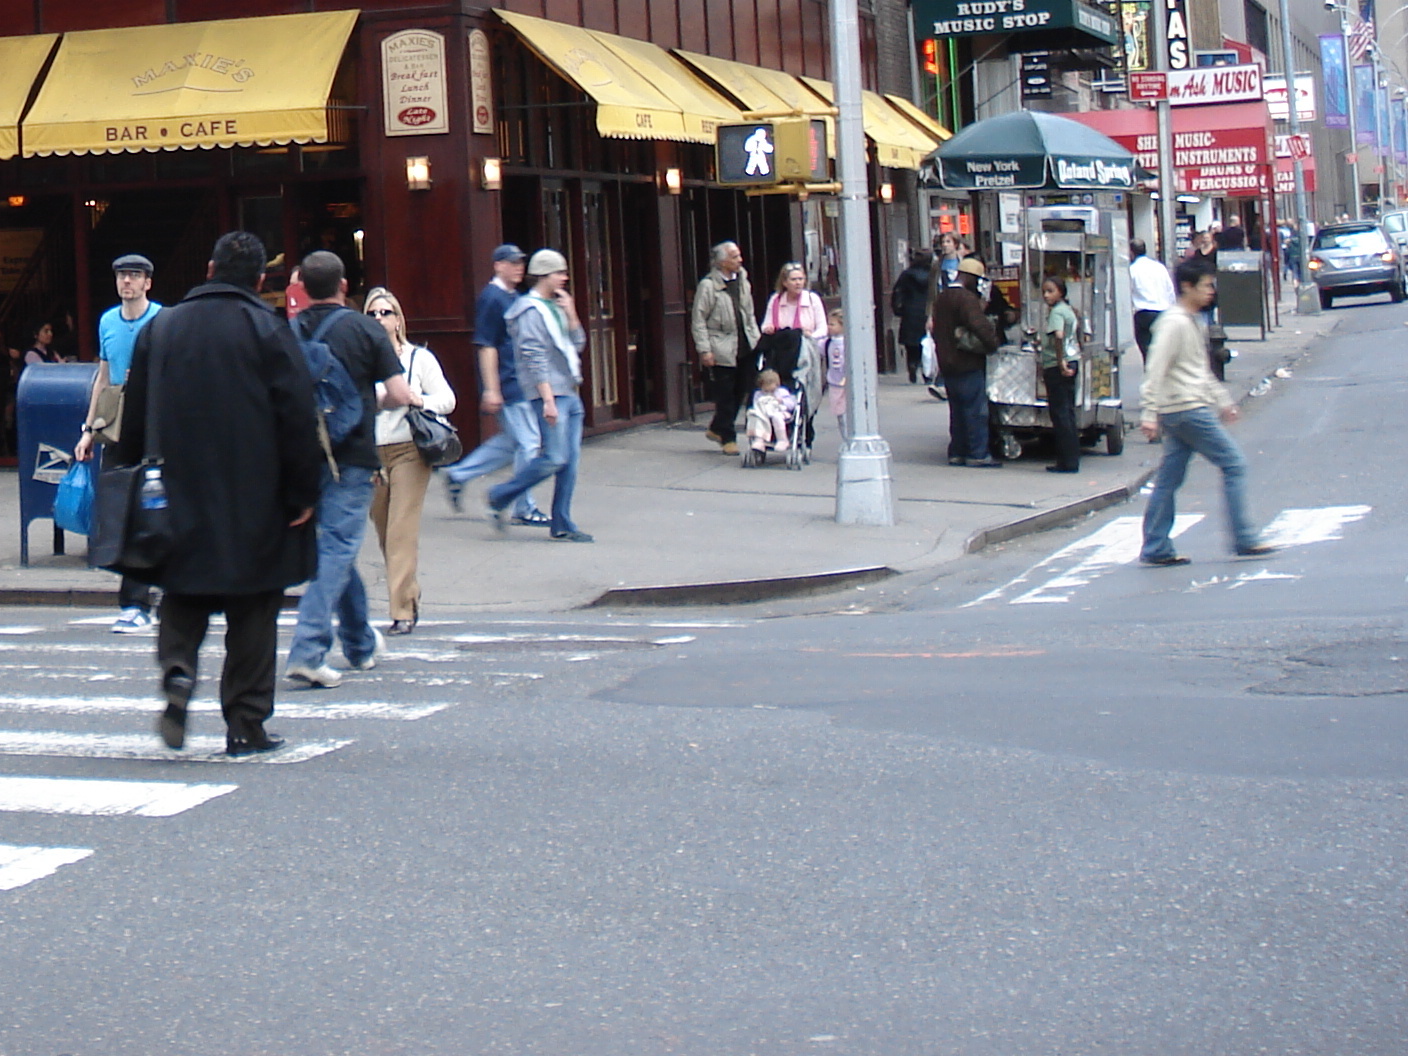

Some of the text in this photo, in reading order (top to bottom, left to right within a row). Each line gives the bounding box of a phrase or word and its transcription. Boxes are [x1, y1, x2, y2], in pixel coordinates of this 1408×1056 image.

[934, 12, 1051, 35] MUSIC STOP
[132, 52, 255, 88] MAXIE'S
[390, 71, 438, 81] Breakfast
[401, 84, 429, 93] Lunch
[1182, 73, 1206, 98] Ash
[1213, 70, 1257, 96] MUSIC
[399, 95, 432, 104] Dinner
[105, 120, 238, 142] BAR CAFE
[1175, 132, 1212, 148] MUSIC
[1175, 147, 1257, 165] INSTRUMENTS
[966, 160, 1020, 173] New York
[1058, 159, 1131, 186] Poland Spring
[1200, 165, 1242, 176] DRUMS
[975, 174, 1015, 187] Pretzel
